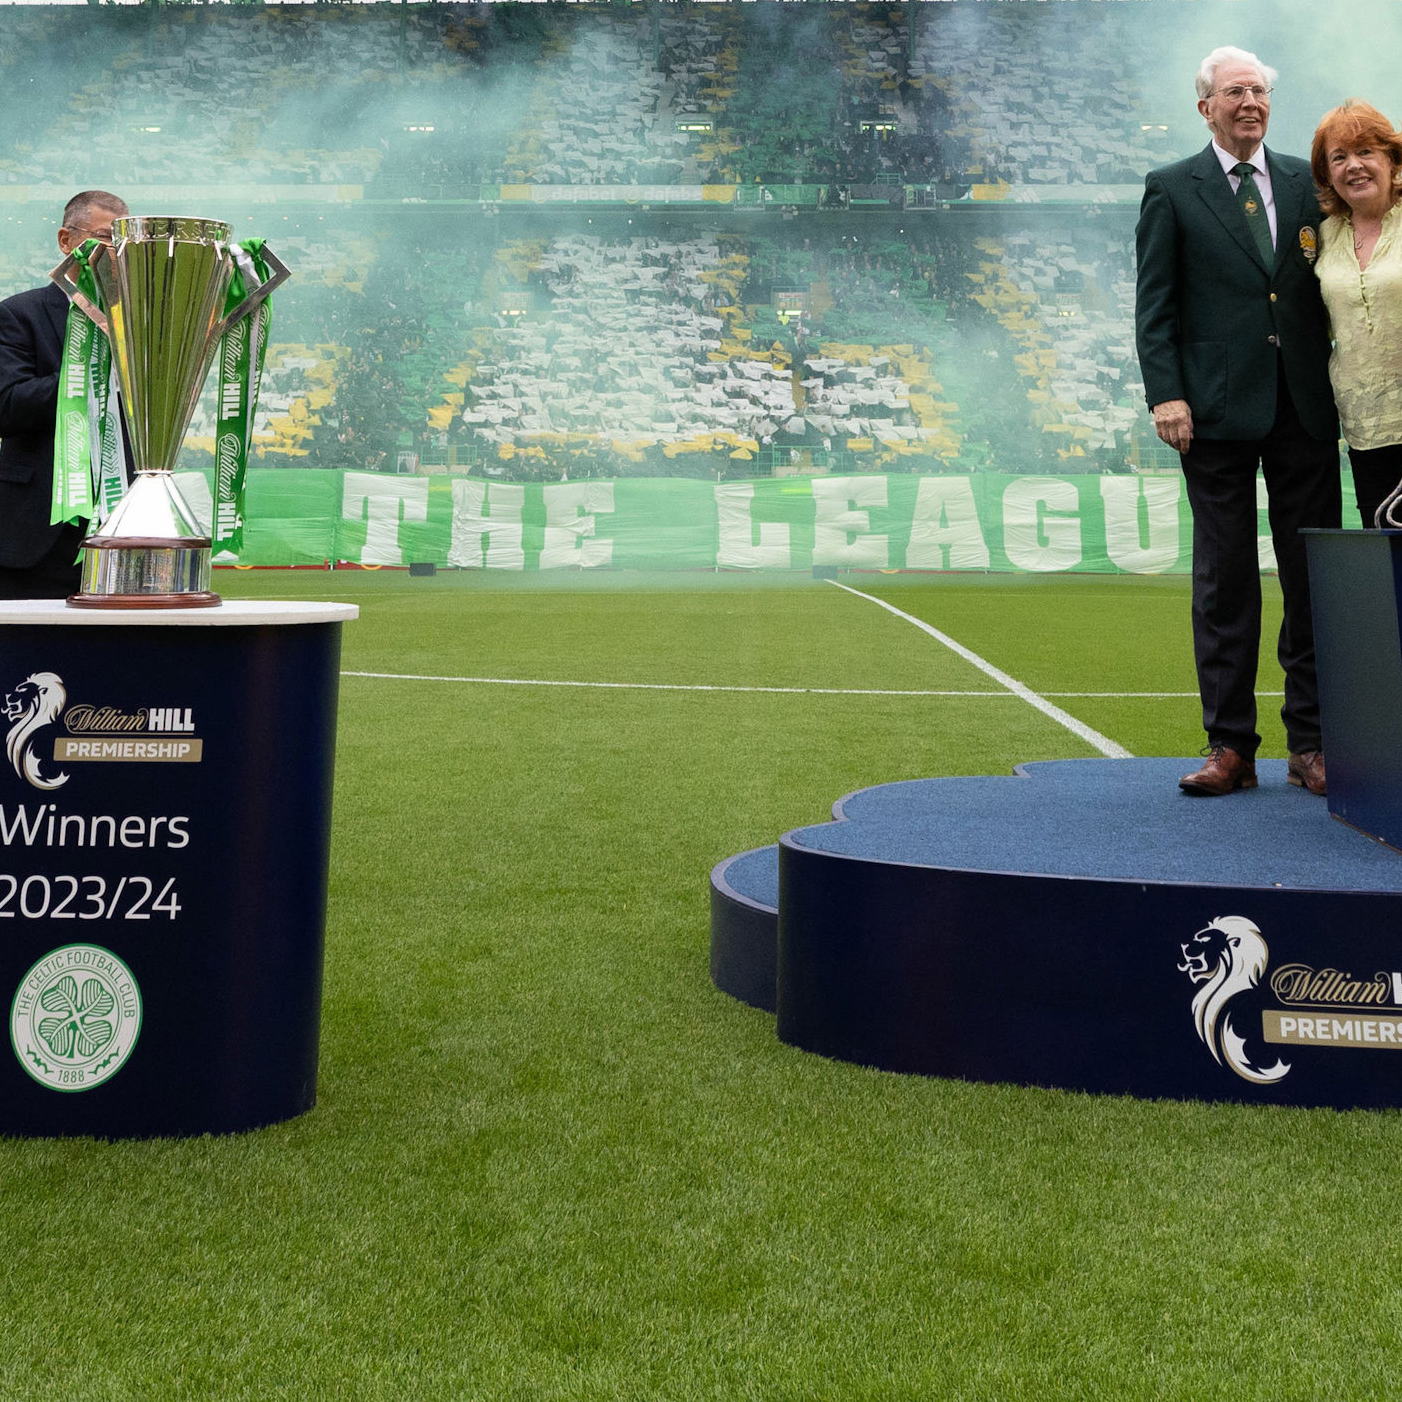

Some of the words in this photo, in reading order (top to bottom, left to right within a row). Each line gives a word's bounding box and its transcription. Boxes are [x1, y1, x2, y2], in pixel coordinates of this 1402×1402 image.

[67, 363, 86, 399] HILL
[222, 383, 240, 421] HILL
[65, 410, 87, 473] William
[218, 432, 242, 503] William
[67, 472, 88, 507] HILL
[216, 503, 236, 542] HILL
[341, 471, 616, 570] THE
[713, 475, 1281, 575] LEAGU
[64, 704, 149, 733] William
[148, 707, 195, 731] HILL
[65, 742, 190, 758] PREMIERSHIP
[18, 991, 35, 1018] THE
[28, 955, 65, 989] CELTIC
[67, 951, 123, 984] FOOTBALL
[119, 983, 136, 1019] CLUB
[1270, 963, 1392, 1008] William
[58, 1069, 85, 1083] 1888
